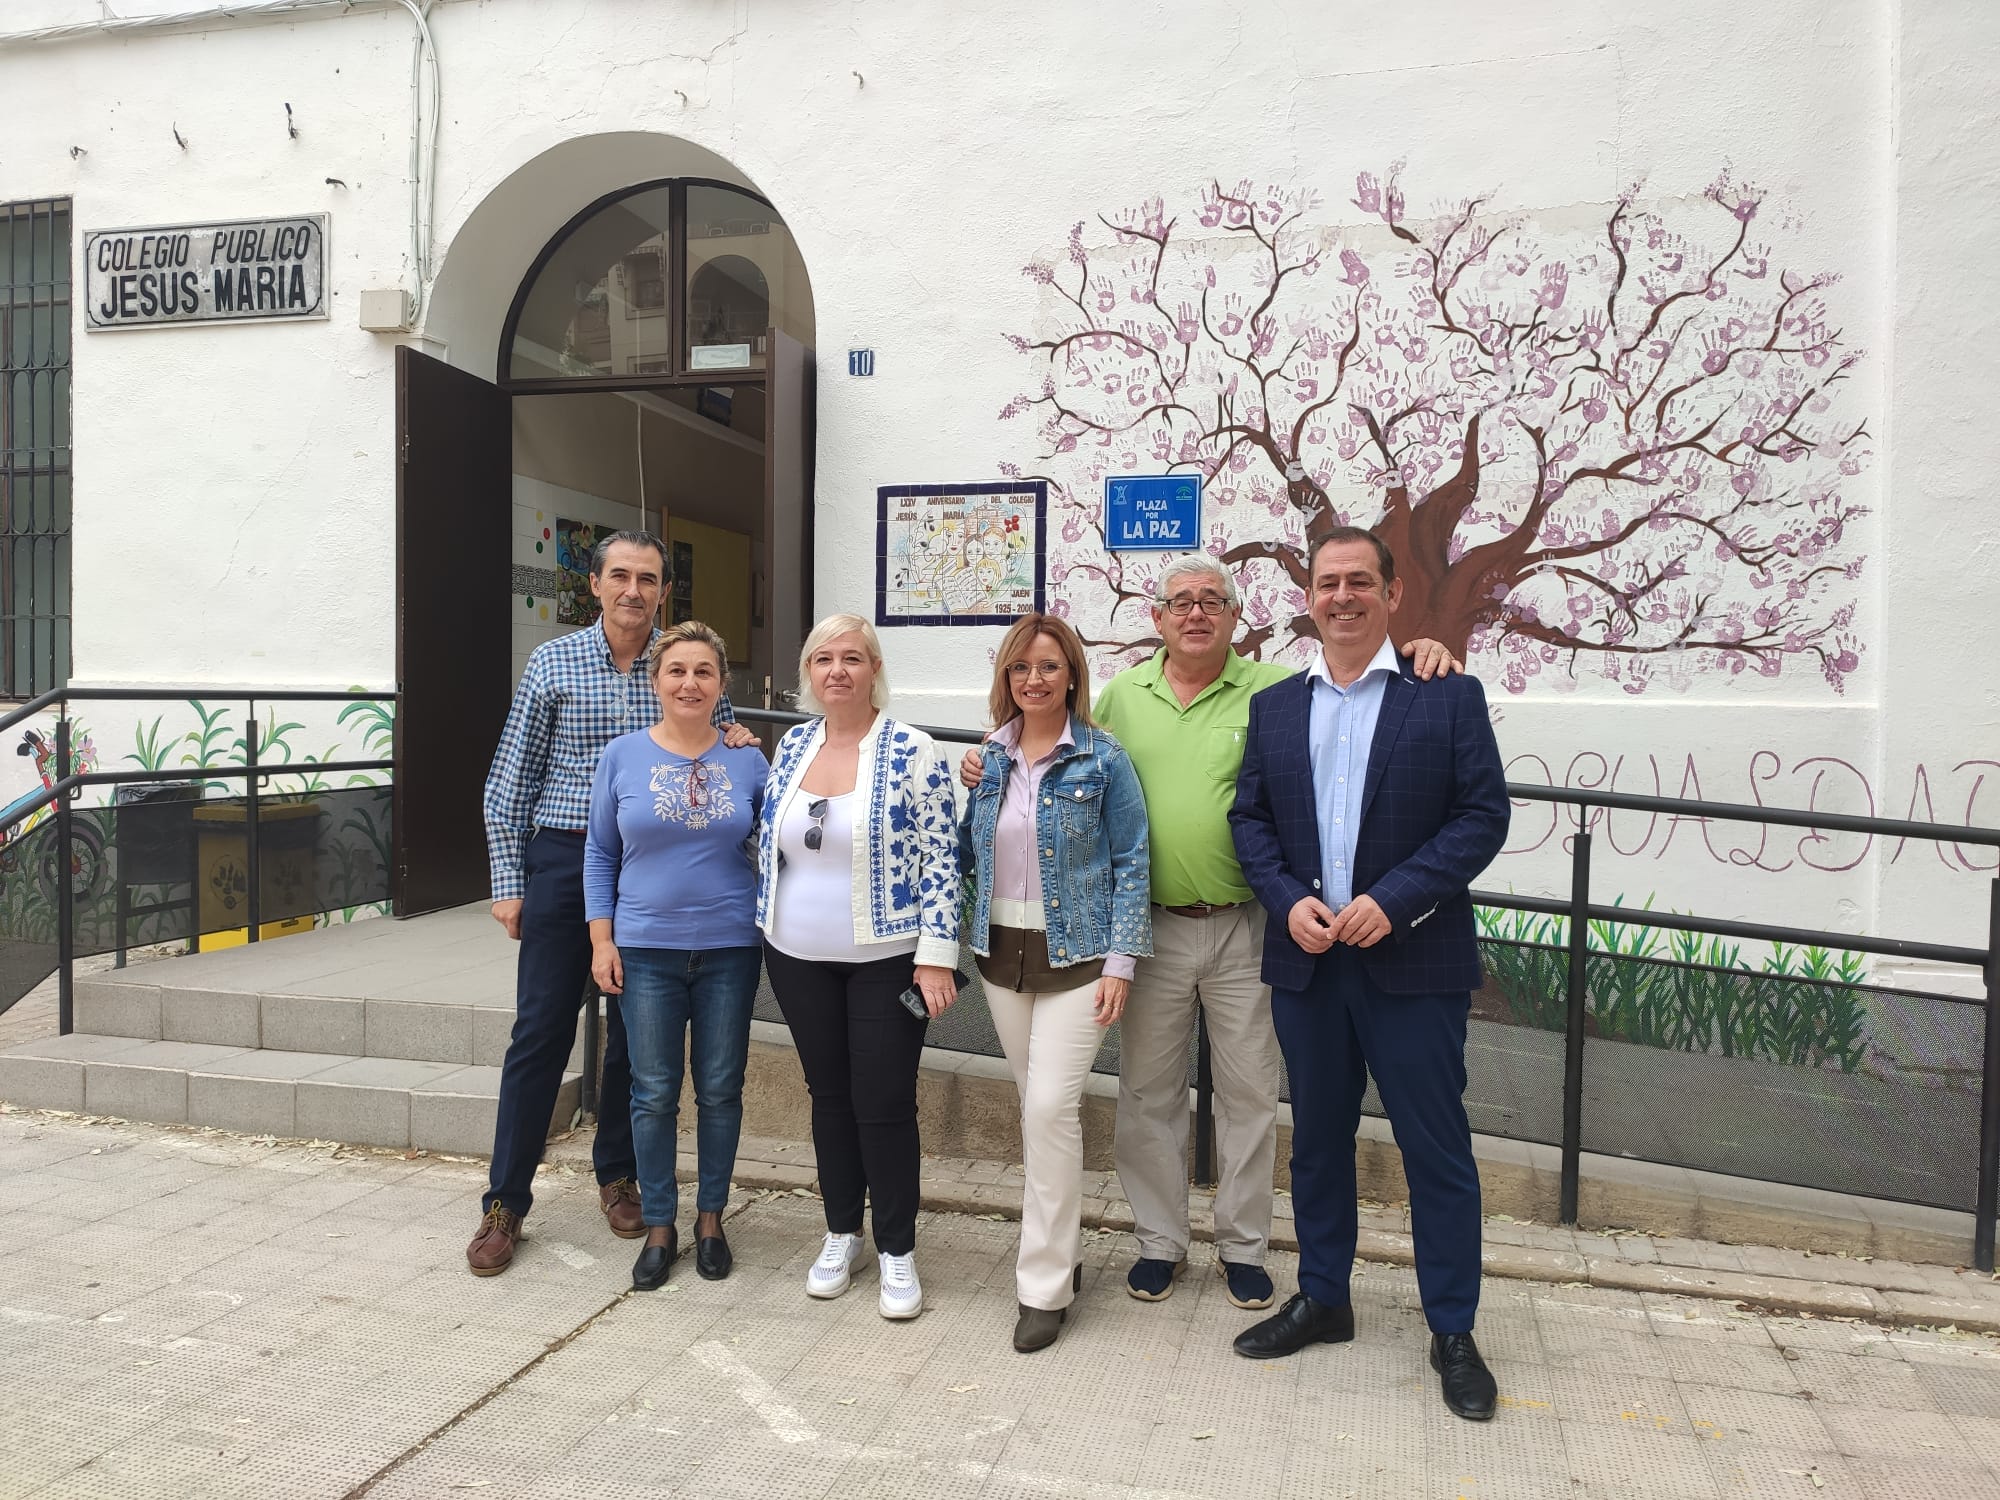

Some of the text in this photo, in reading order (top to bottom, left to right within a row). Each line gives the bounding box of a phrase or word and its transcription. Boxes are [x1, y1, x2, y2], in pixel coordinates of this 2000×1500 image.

[97, 225, 311, 272] COLEGIO PUBLICO
[851, 350, 871, 376] 10
[900, 495, 1034, 507] LXXV ANIVERSARIO DEL COLEGIO
[1136, 500, 1167, 511] PLAZA
[1123, 520, 1181, 539] LA PAZ
[995, 603, 1011, 613] 1925
[1017, 603, 1033, 613] 2000
